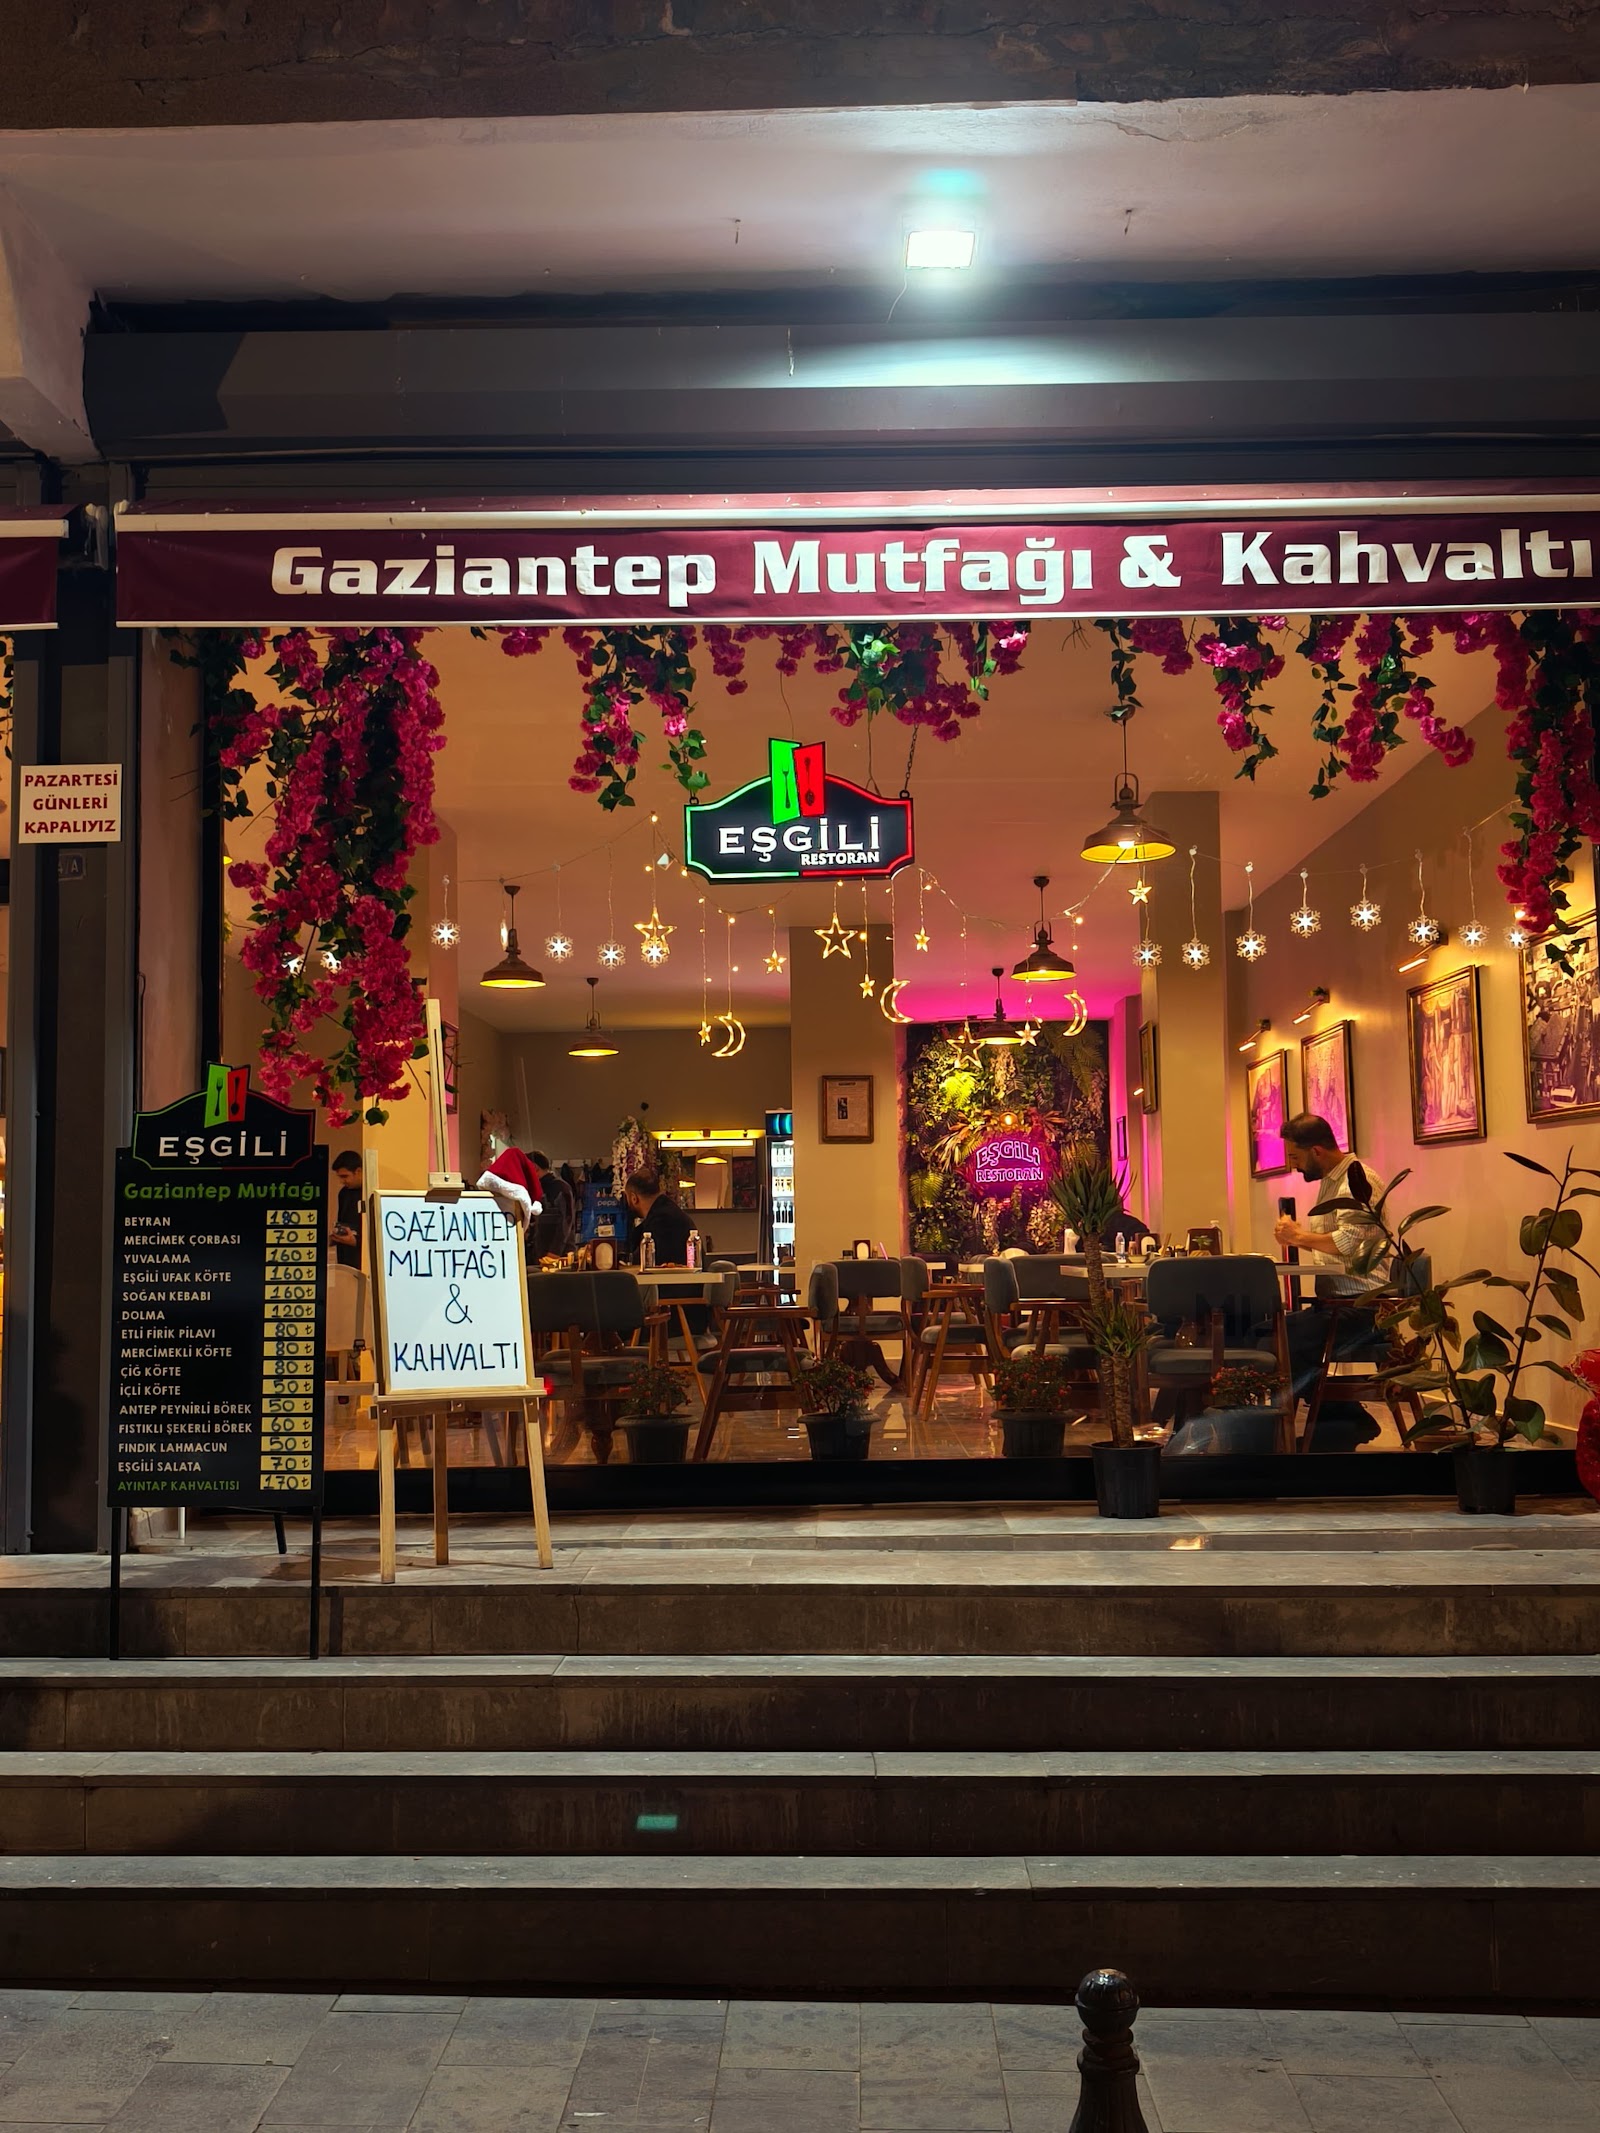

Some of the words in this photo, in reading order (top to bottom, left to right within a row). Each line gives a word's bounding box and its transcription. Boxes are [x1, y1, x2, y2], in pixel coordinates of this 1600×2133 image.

[271, 544, 717, 608] Gaziantep
[753, 536, 1094, 606] Mutfağı
[1119, 534, 1182, 589] &
[1220, 528, 1593, 587] Kahvaltı
[24, 769, 118, 787] PAZARTESİ
[33, 793, 108, 811] GÜNLERİ
[24, 819, 116, 834] KAPALIYIZ
[718, 815, 880, 863] EŞGİLİ
[801, 850, 880, 866] RESTORAN
[159, 1131, 286, 1164] EŞGİLİ
[976, 1140, 1041, 1169] EŞGİLİ
[976, 1168, 1044, 1182] RESTORAN
[124, 1183, 230, 1202] Gaziantep
[238, 1182, 320, 1201] Mutfağı
[124, 1217, 171, 1226] BEYRAN
[385, 1206, 516, 1241] GAZİANTEP
[124, 1233, 185, 1245] MERCİMEK
[189, 1235, 240, 1247] ÇORBASI
[273, 1230, 298, 1243] 70
[124, 1254, 191, 1263] YUVALAMA
[268, 1249, 301, 1262] 160
[389, 1245, 506, 1279] MUTFAĞI
[123, 1270, 159, 1284] EŞGİLİ
[163, 1273, 191, 1282] UFAK
[194, 1269, 232, 1282] KÖFTE
[270, 1267, 303, 1280] 160
[123, 1289, 165, 1301] SOĞAN
[169, 1291, 211, 1301] KEBABI
[270, 1286, 305, 1299] 160
[445, 1284, 472, 1324] &
[122, 1311, 165, 1320] DOLMA
[271, 1305, 304, 1318] 120
[122, 1327, 143, 1339] ETLİ
[147, 1326, 175, 1339] FİRİK
[179, 1326, 215, 1338] PİLAVI
[274, 1322, 298, 1337] 80
[121, 1345, 192, 1358] MERCİMEKLİ
[196, 1345, 232, 1357] KÖFTE
[276, 1341, 299, 1356] 80
[394, 1342, 518, 1372] KAHVALTI
[121, 1364, 141, 1378] ÇİĞ
[145, 1364, 181, 1376] KÖFTE
[275, 1360, 298, 1375] 80
[120, 1383, 141, 1397] İÇLİ
[144, 1383, 181, 1395] KÖFTE
[273, 1379, 299, 1393] 50
[119, 1405, 156, 1415] ANTEP
[160, 1402, 210, 1414] PEYNİRLİ
[214, 1401, 252, 1414] BÖREK
[269, 1399, 295, 1412] 50
[119, 1424, 163, 1434] FISTIKLI
[166, 1421, 211, 1435] ŞEKERLİ
[214, 1420, 252, 1433] BÖREK
[271, 1417, 294, 1432] 60
[119, 1443, 156, 1453] FINDIK
[160, 1443, 227, 1452] LAHMACUN
[270, 1437, 297, 1451] 50
[118, 1459, 154, 1474] EŞGİLİ
[157, 1462, 201, 1471] SALATA
[270, 1457, 297, 1471] 70
[118, 1481, 167, 1491] AYINTAP
[171, 1481, 239, 1490] KAHVALTISI
[263, 1475, 299, 1490] 170
